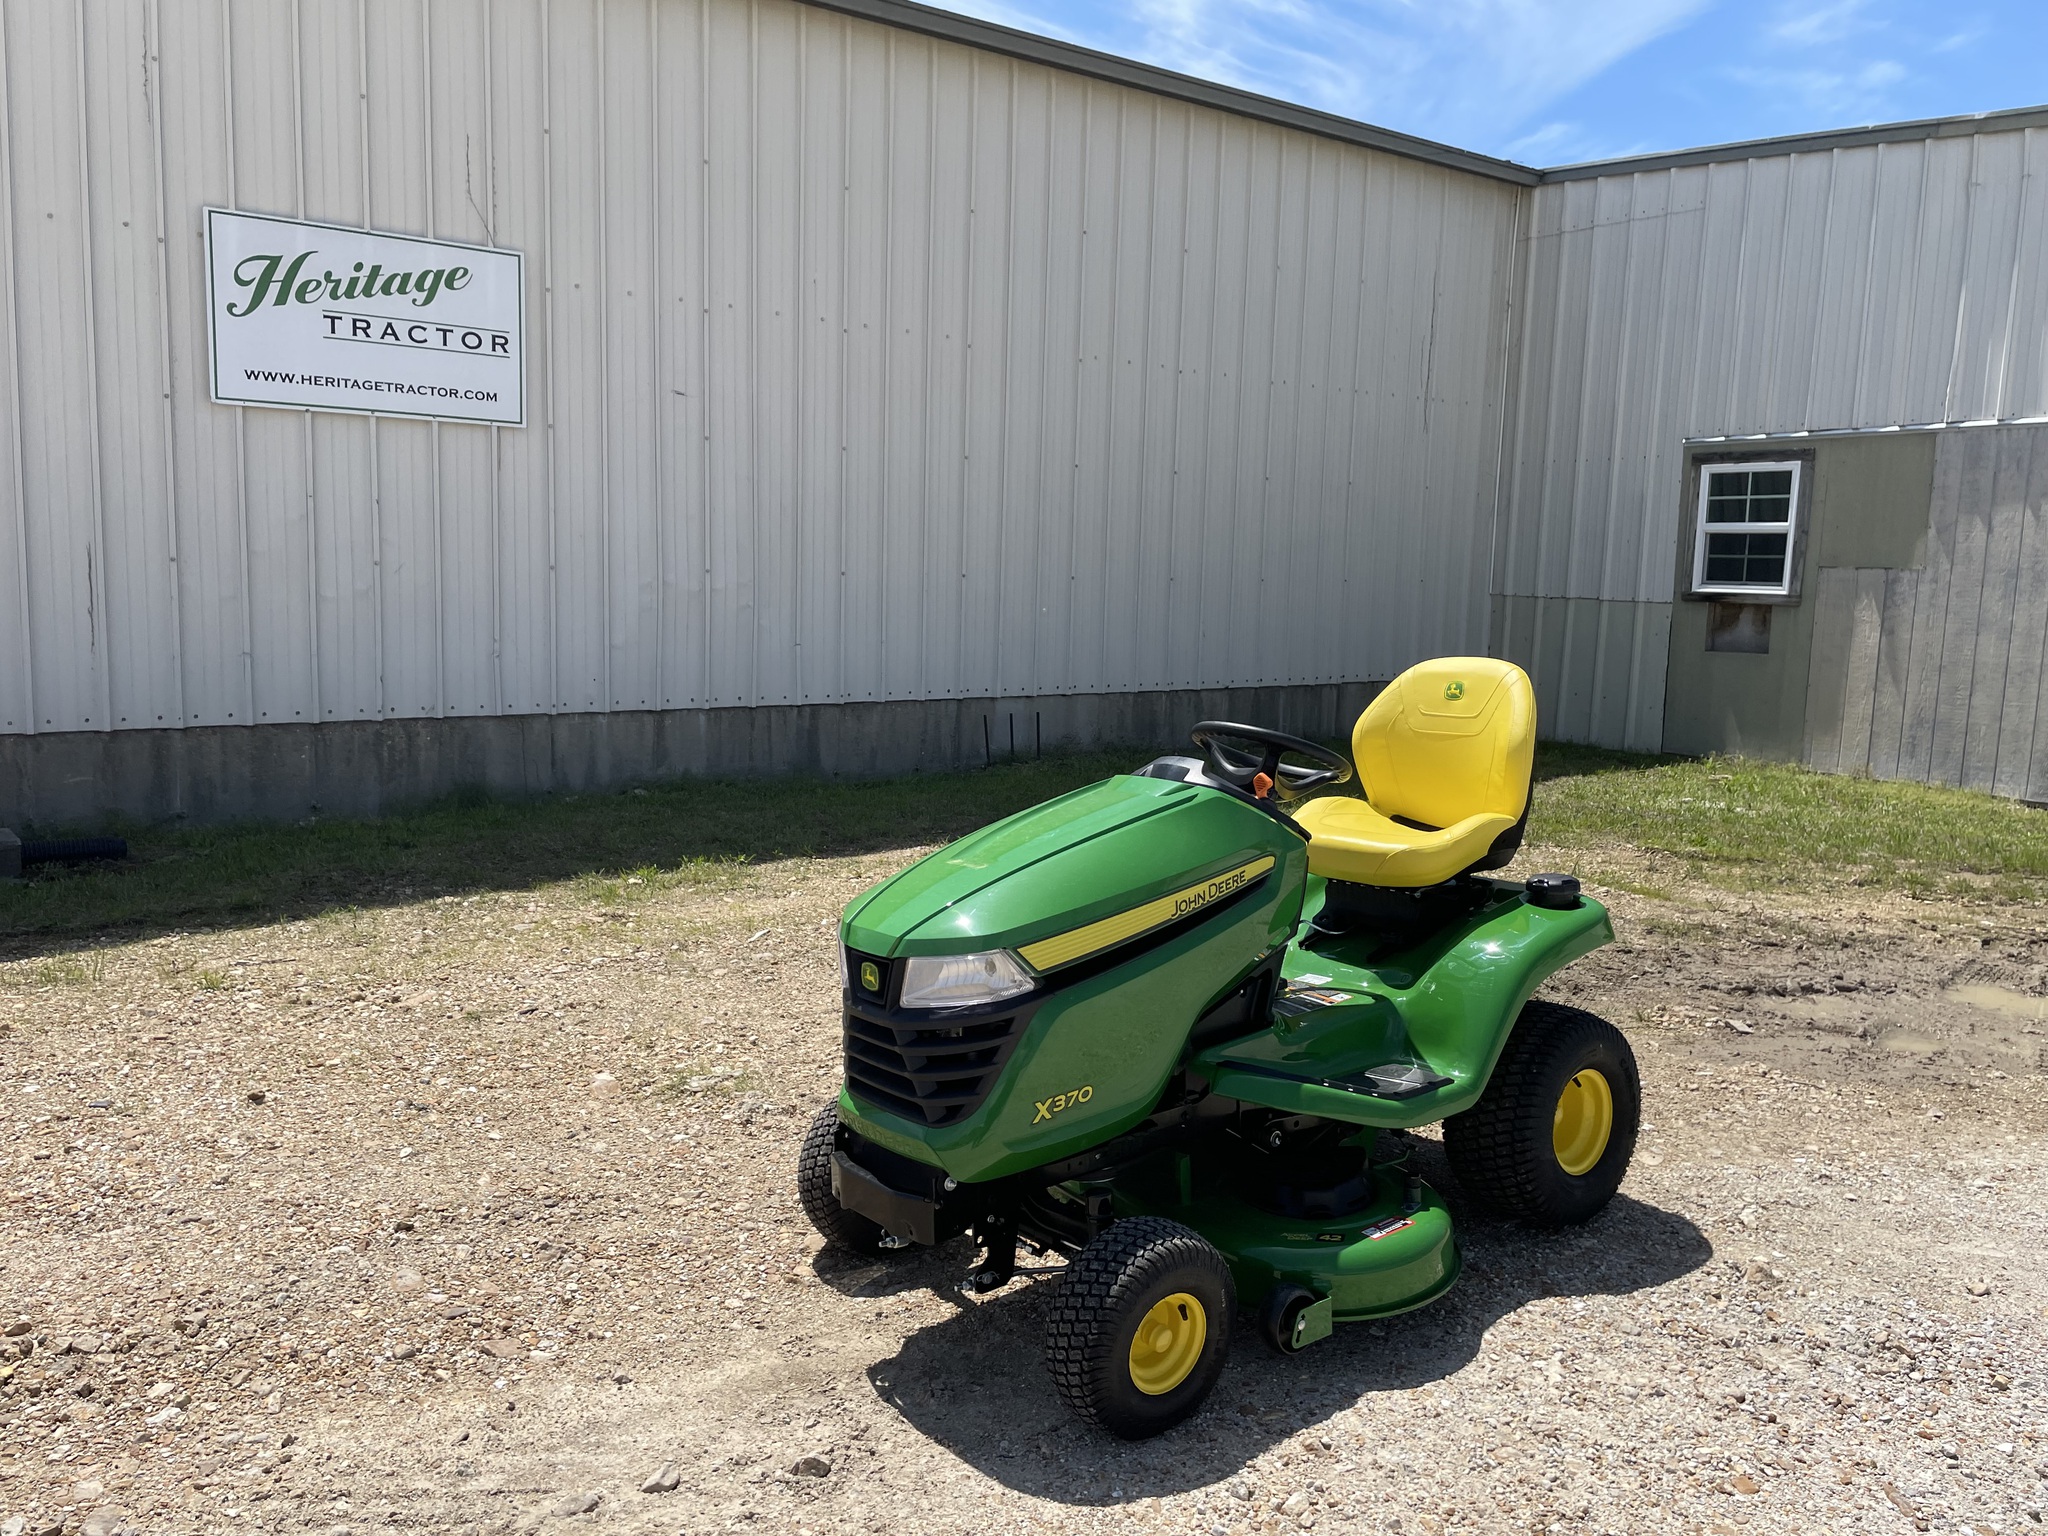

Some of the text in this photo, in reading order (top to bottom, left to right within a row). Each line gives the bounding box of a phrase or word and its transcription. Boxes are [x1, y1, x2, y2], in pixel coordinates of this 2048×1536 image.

[226, 250, 473, 317] Heritage
[323, 314, 510, 354] TRACTOR
[244, 369, 498, 402] WWW.HERITAGETRACTOR.COM
[1171, 870, 1247, 917] JOHN DEERE
[1031, 1085, 1093, 1124] X370
